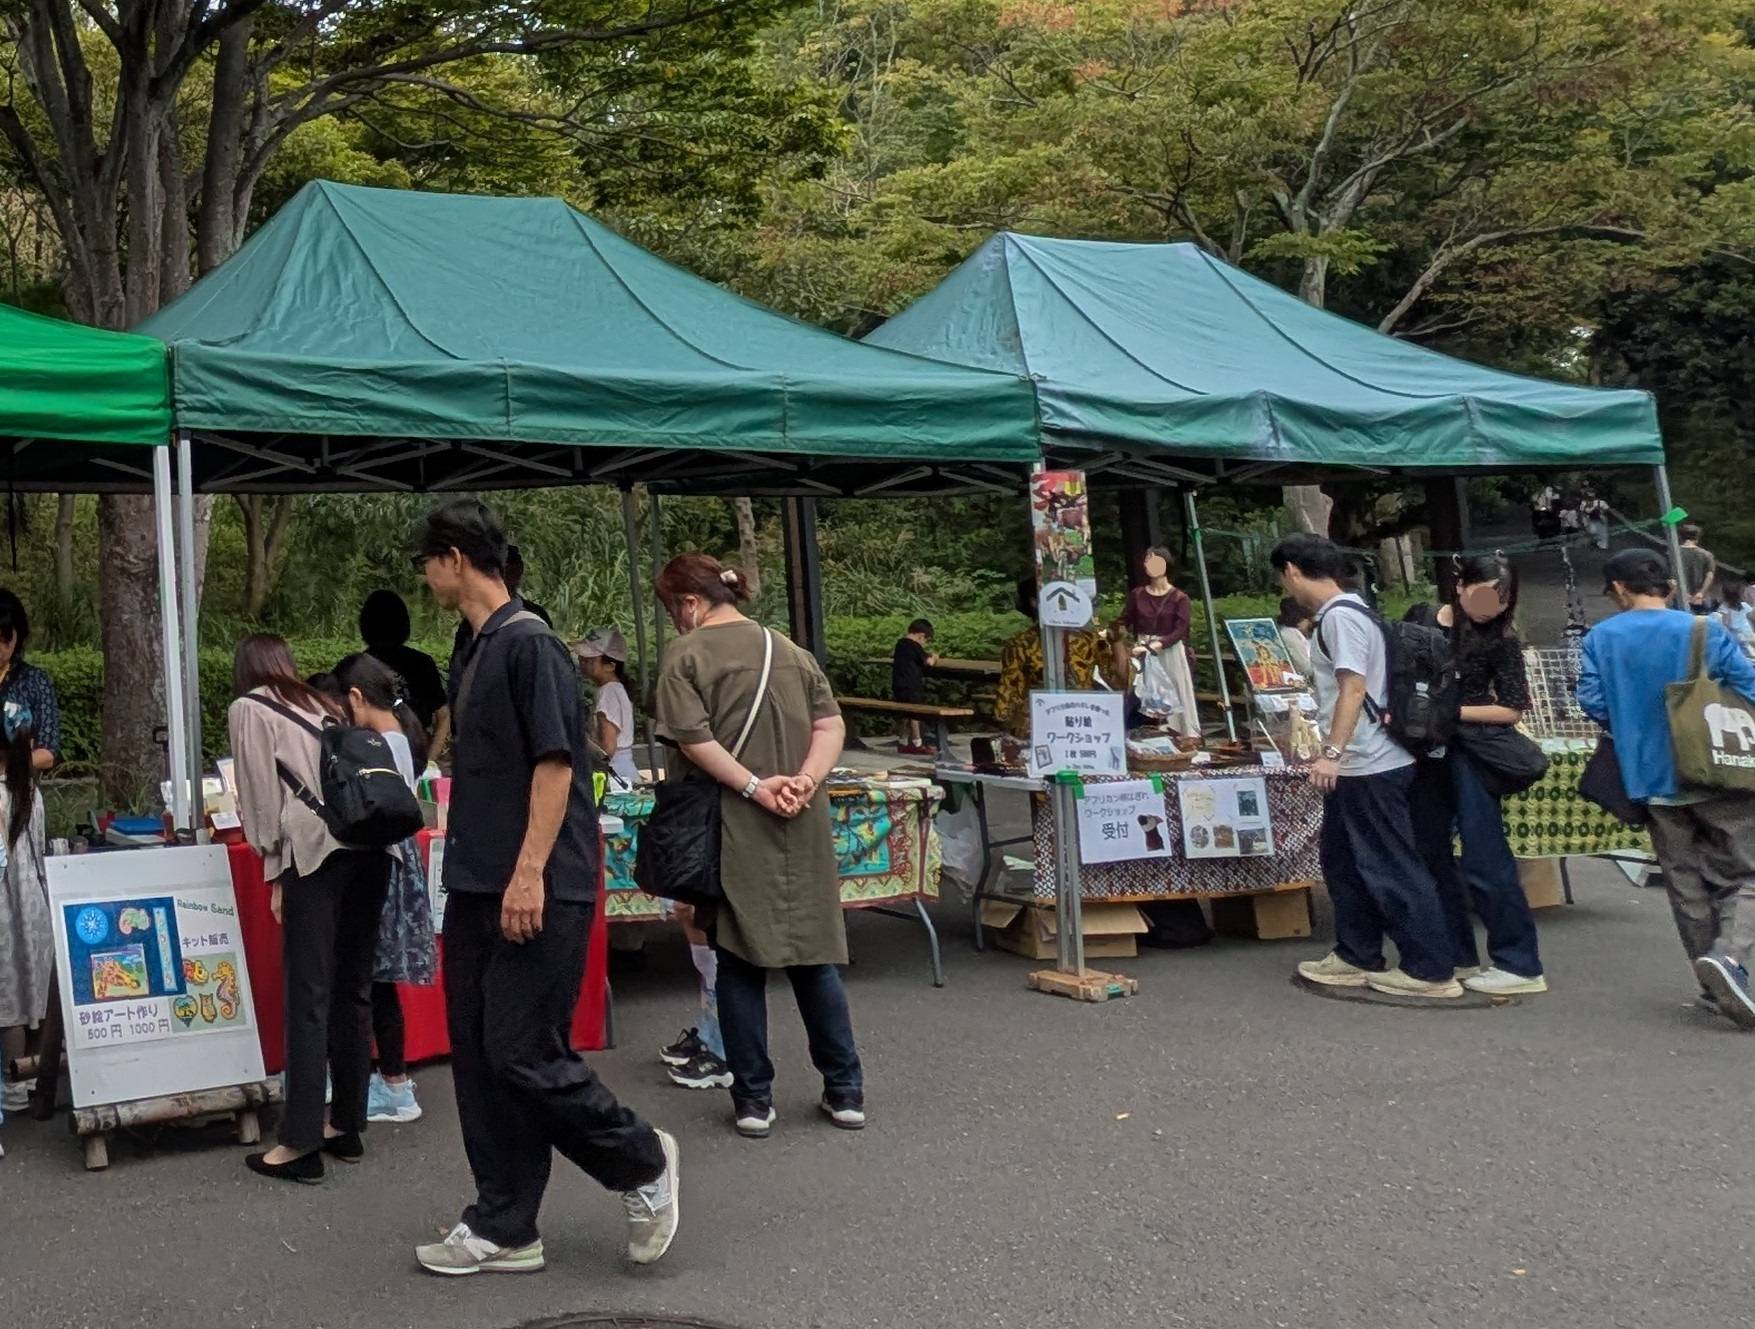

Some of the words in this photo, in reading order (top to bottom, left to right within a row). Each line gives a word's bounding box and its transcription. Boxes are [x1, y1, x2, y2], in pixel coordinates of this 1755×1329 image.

[1046, 732, 1111, 744] ワークショップ
[1101, 821, 1129, 841] 受付
[177, 899, 208, 912] Rainbow
[210, 901, 235, 916] Sand
[182, 932, 230, 949] キット販売
[79, 1004, 159, 1026] 砂絵アート作り
